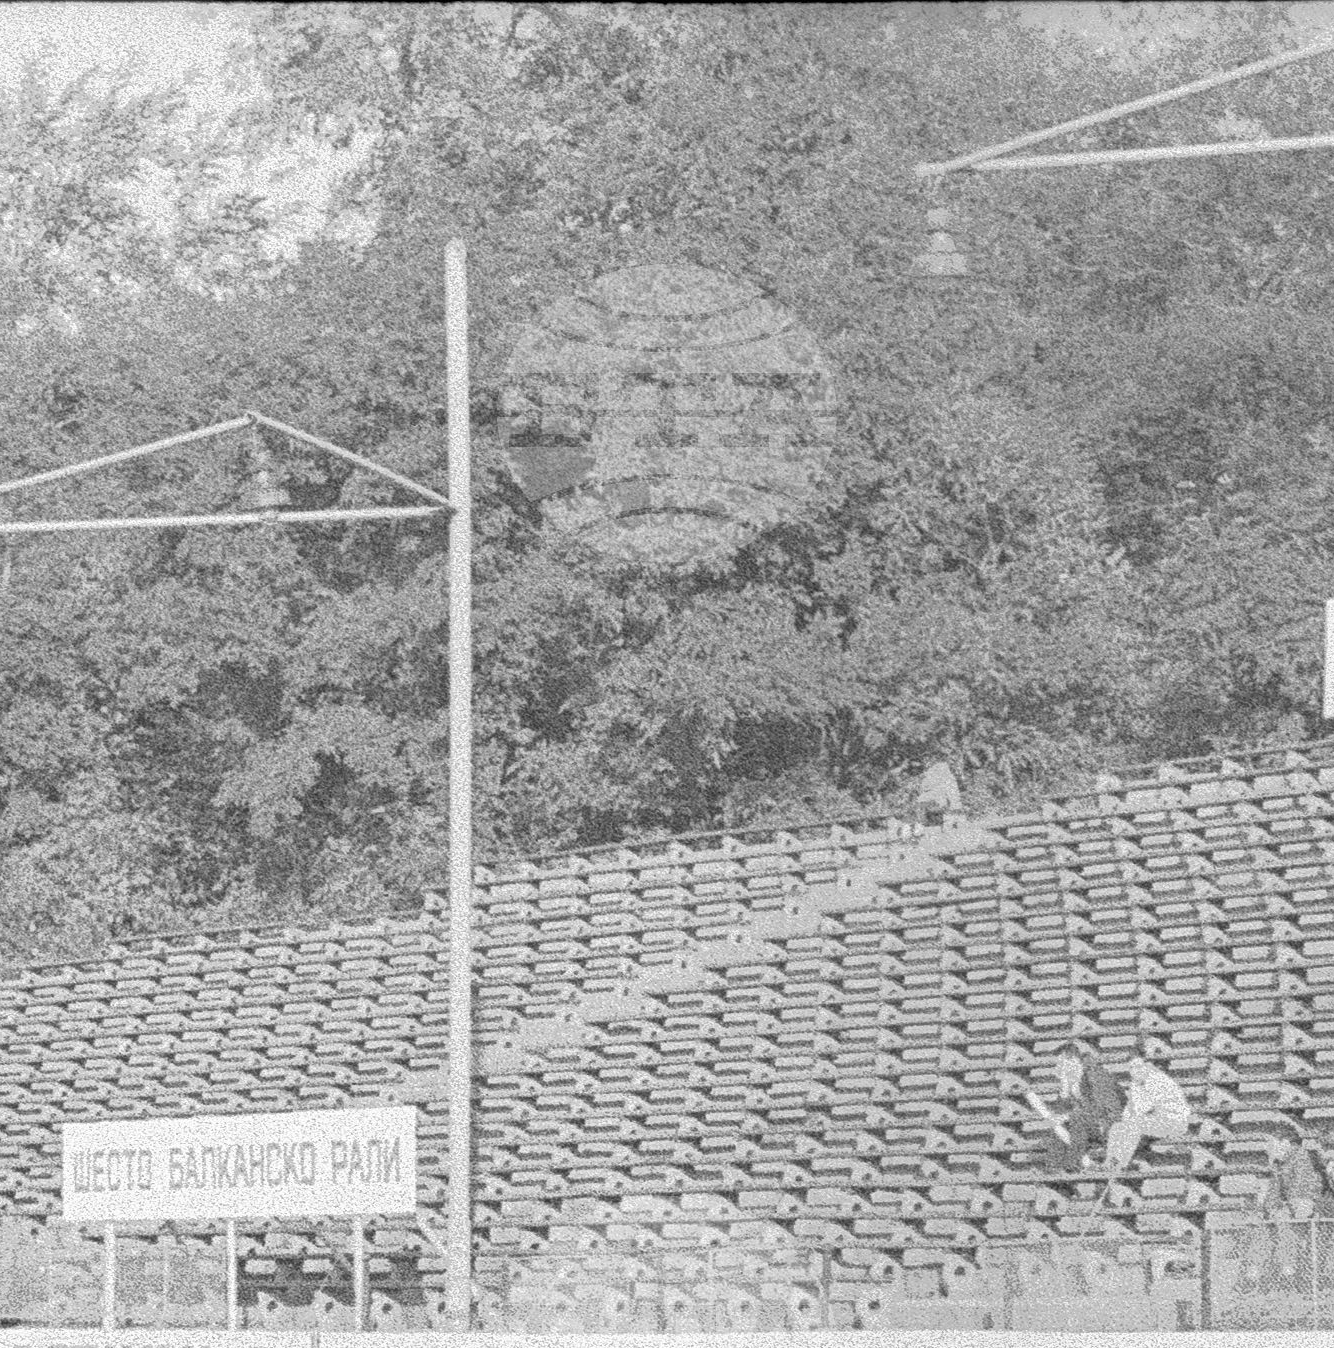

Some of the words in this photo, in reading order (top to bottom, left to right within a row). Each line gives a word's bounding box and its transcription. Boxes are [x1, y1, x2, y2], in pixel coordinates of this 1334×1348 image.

[72, 1148, 153, 1194] ШЕСТО
[168, 1140, 316, 1191] БАЛКАНСКО
[331, 1135, 402, 1185] РАЛИ
